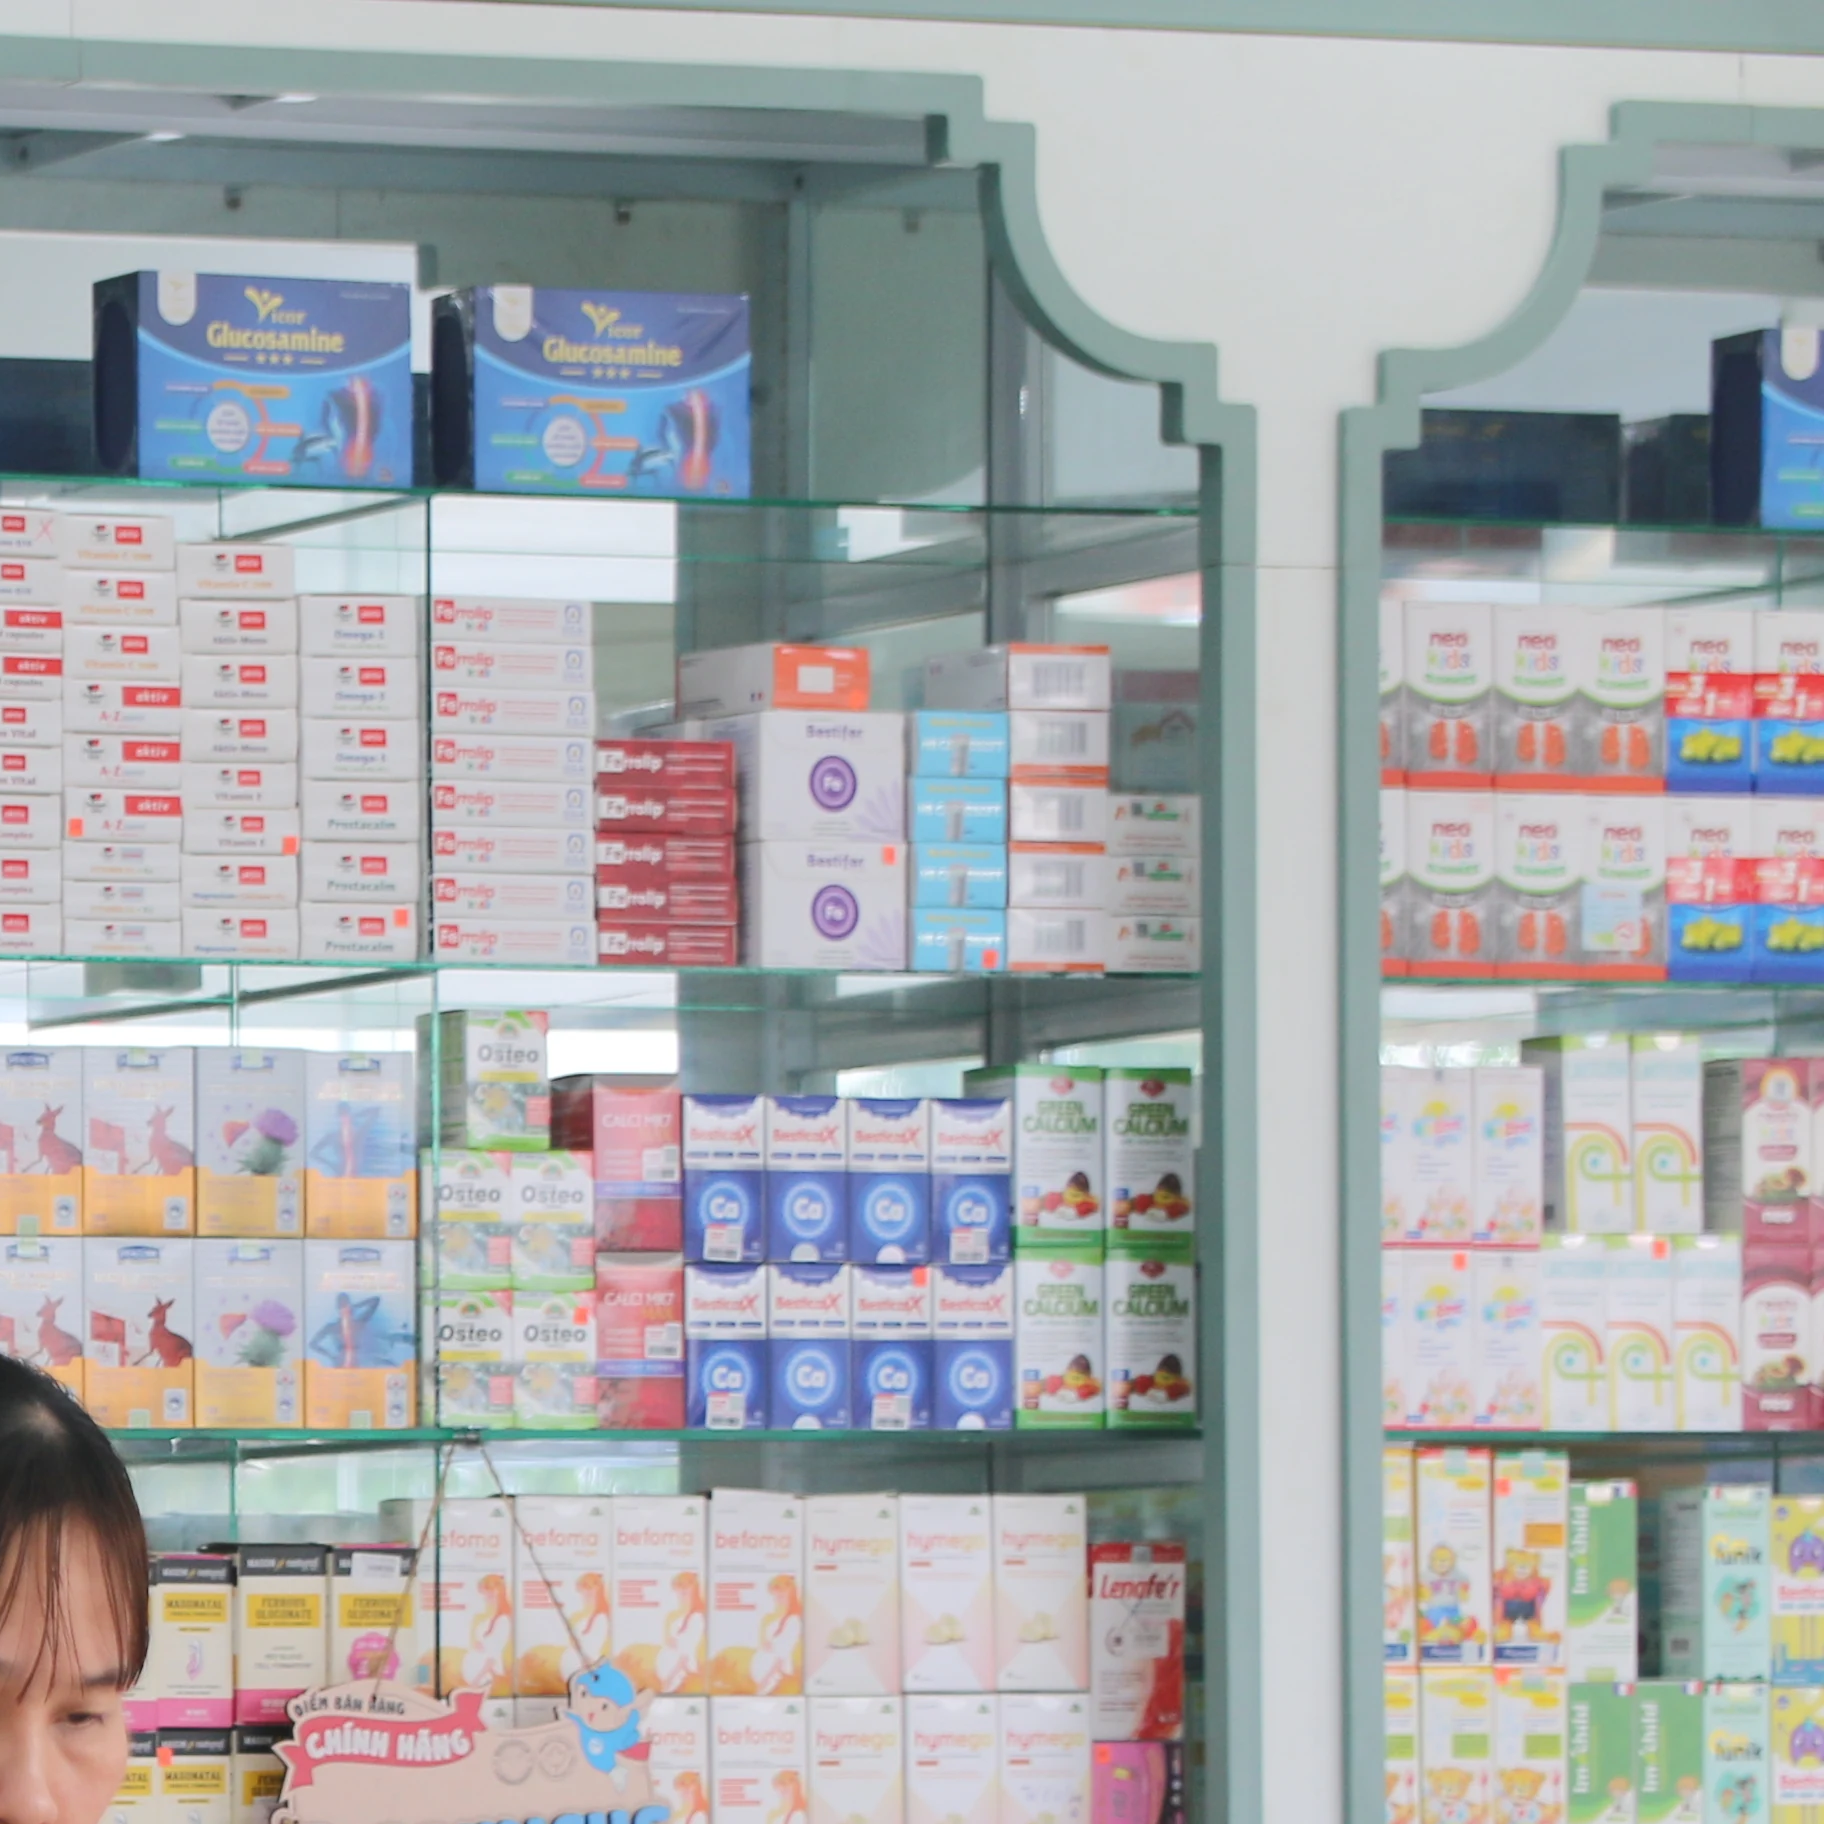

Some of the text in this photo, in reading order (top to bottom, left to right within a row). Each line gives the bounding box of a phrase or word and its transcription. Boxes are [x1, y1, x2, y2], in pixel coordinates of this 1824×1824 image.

[207, 321, 344, 353] Glucosamine
[1518, 634, 1557, 650] neo
[135, 691, 168, 703] aktiv
[477, 1045, 539, 1065] Osteo
[1113, 1117, 1190, 1136] CALCIUM
[874, 1200, 904, 1220] Ca
[1127, 1285, 1175, 1301] GREEN
[305, 1726, 471, 1762] CHÍNH HÃNG
